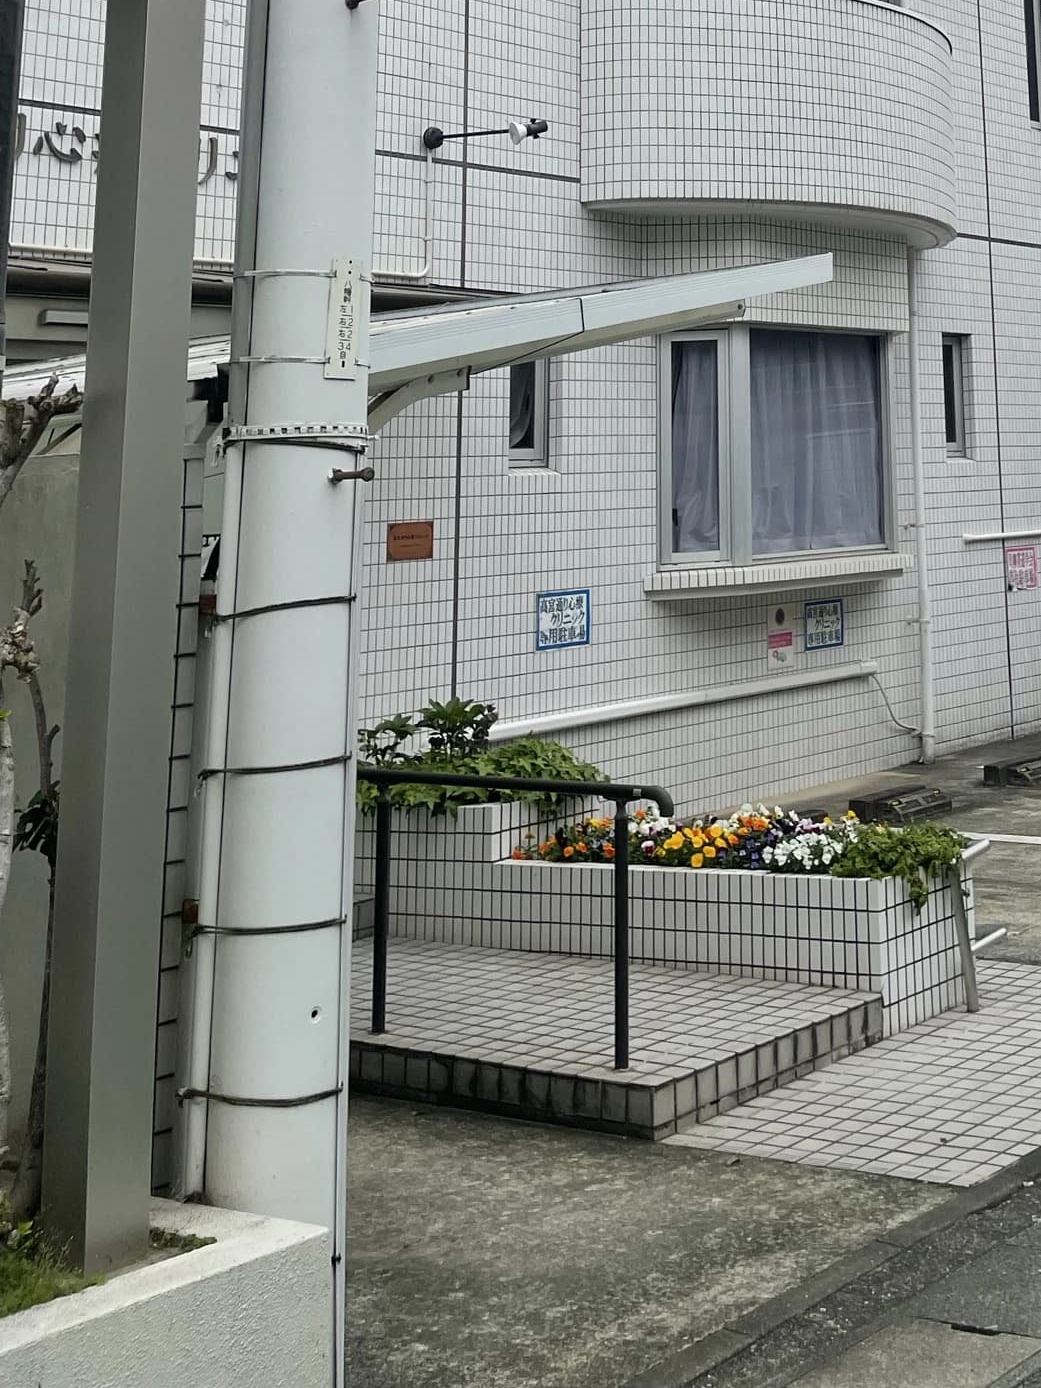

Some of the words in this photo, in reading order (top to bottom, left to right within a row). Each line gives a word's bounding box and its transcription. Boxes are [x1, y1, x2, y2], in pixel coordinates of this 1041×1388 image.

[551, 610, 585, 627] クリニック
[815, 617, 840, 631] クリニック
[540, 625, 585, 644] 専用駐車場
